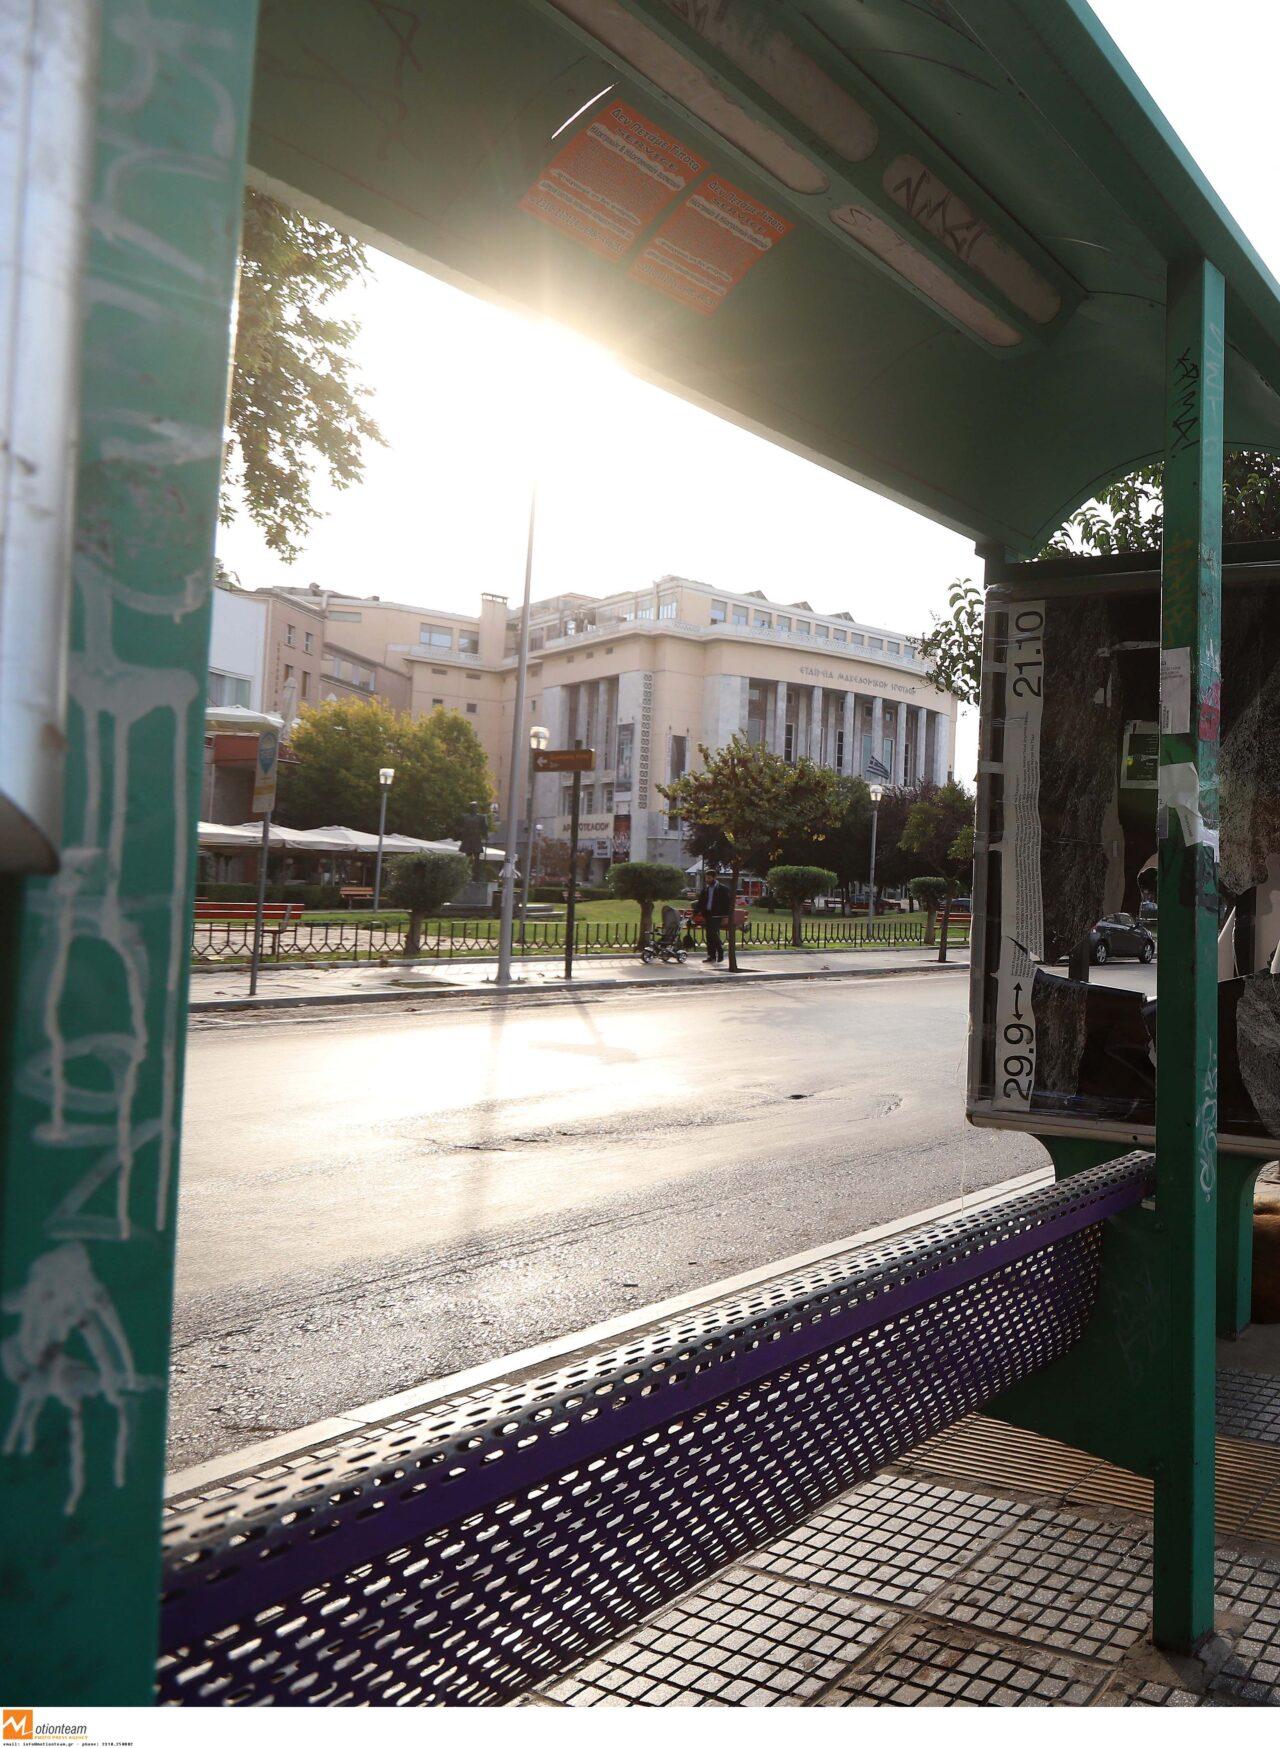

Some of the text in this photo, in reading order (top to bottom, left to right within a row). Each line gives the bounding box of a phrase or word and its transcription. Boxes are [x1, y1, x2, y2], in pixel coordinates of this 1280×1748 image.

[611, 108, 631, 127] Δεν
[1013, 611, 1043, 697] 21.10
[1004, 1024, 1034, 1100] 29.9
